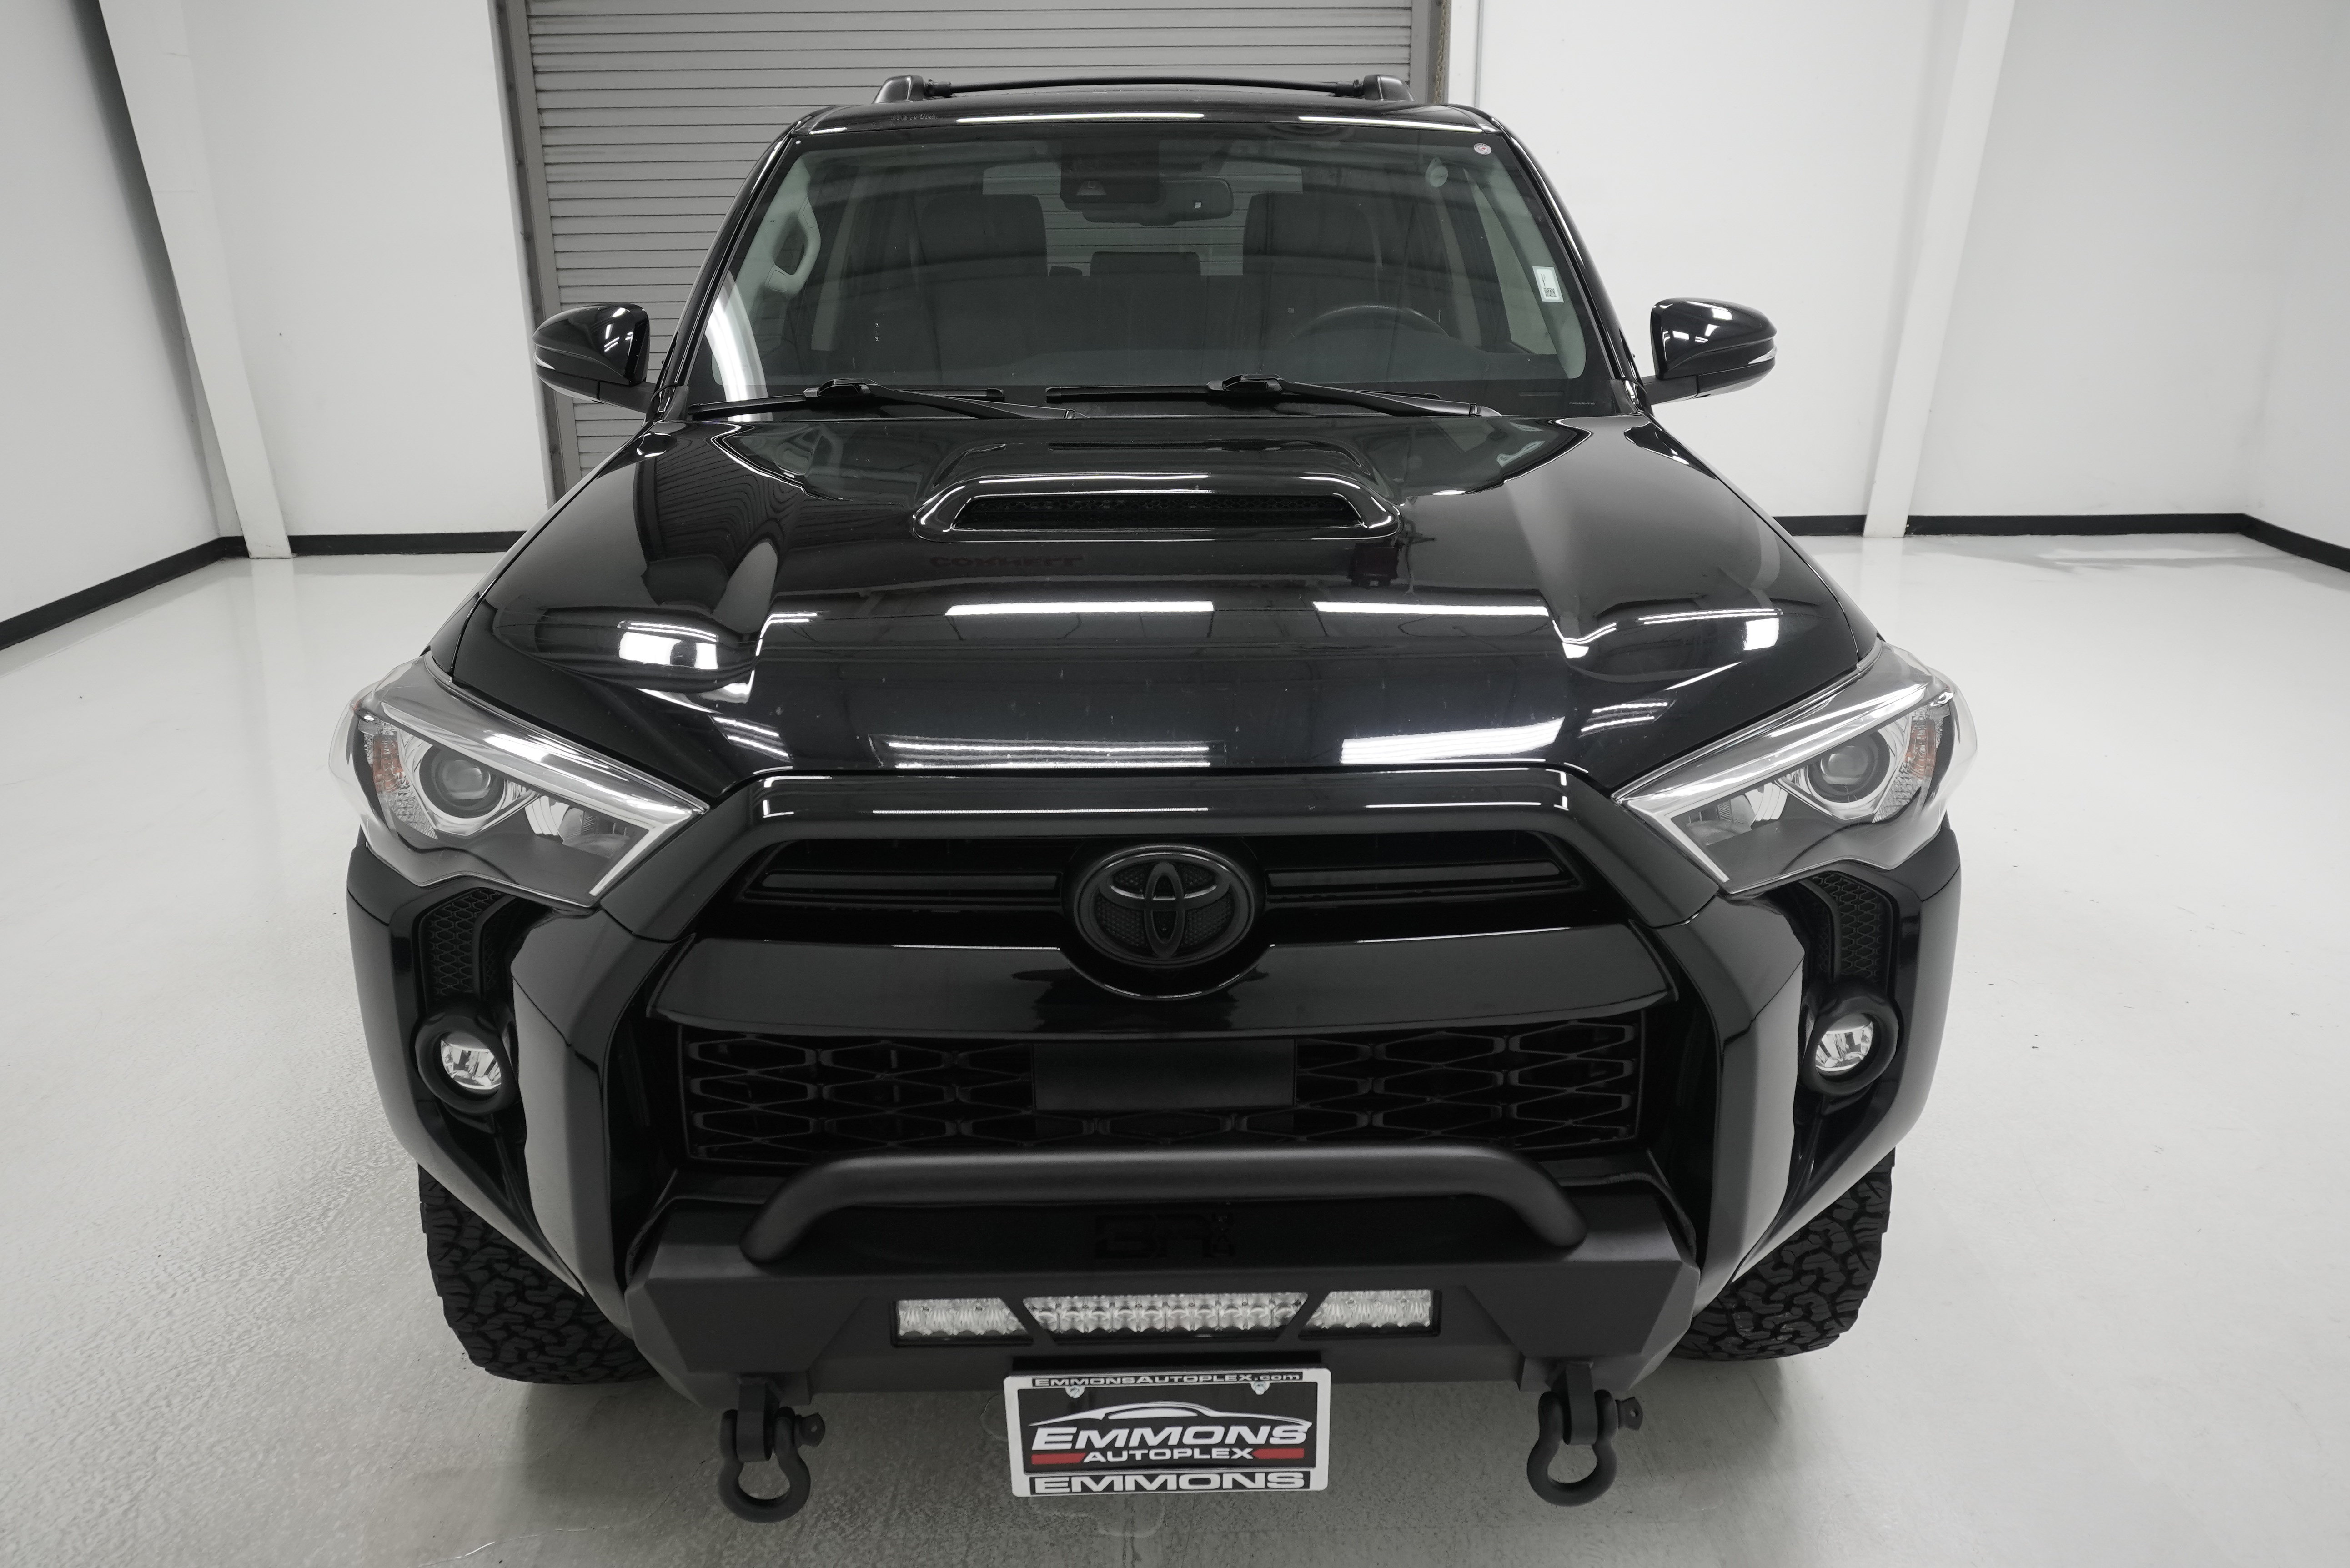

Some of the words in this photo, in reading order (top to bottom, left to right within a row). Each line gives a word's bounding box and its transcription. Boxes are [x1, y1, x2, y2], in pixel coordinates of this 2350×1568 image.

[1034, 1374, 1300, 1387] EMMONSAUTOPLEX.com
[1031, 1425, 1308, 1451] EMMONS
[1083, 1447, 1254, 1463] AUTOPLEX
[1034, 1472, 1305, 1493] EMMONS
